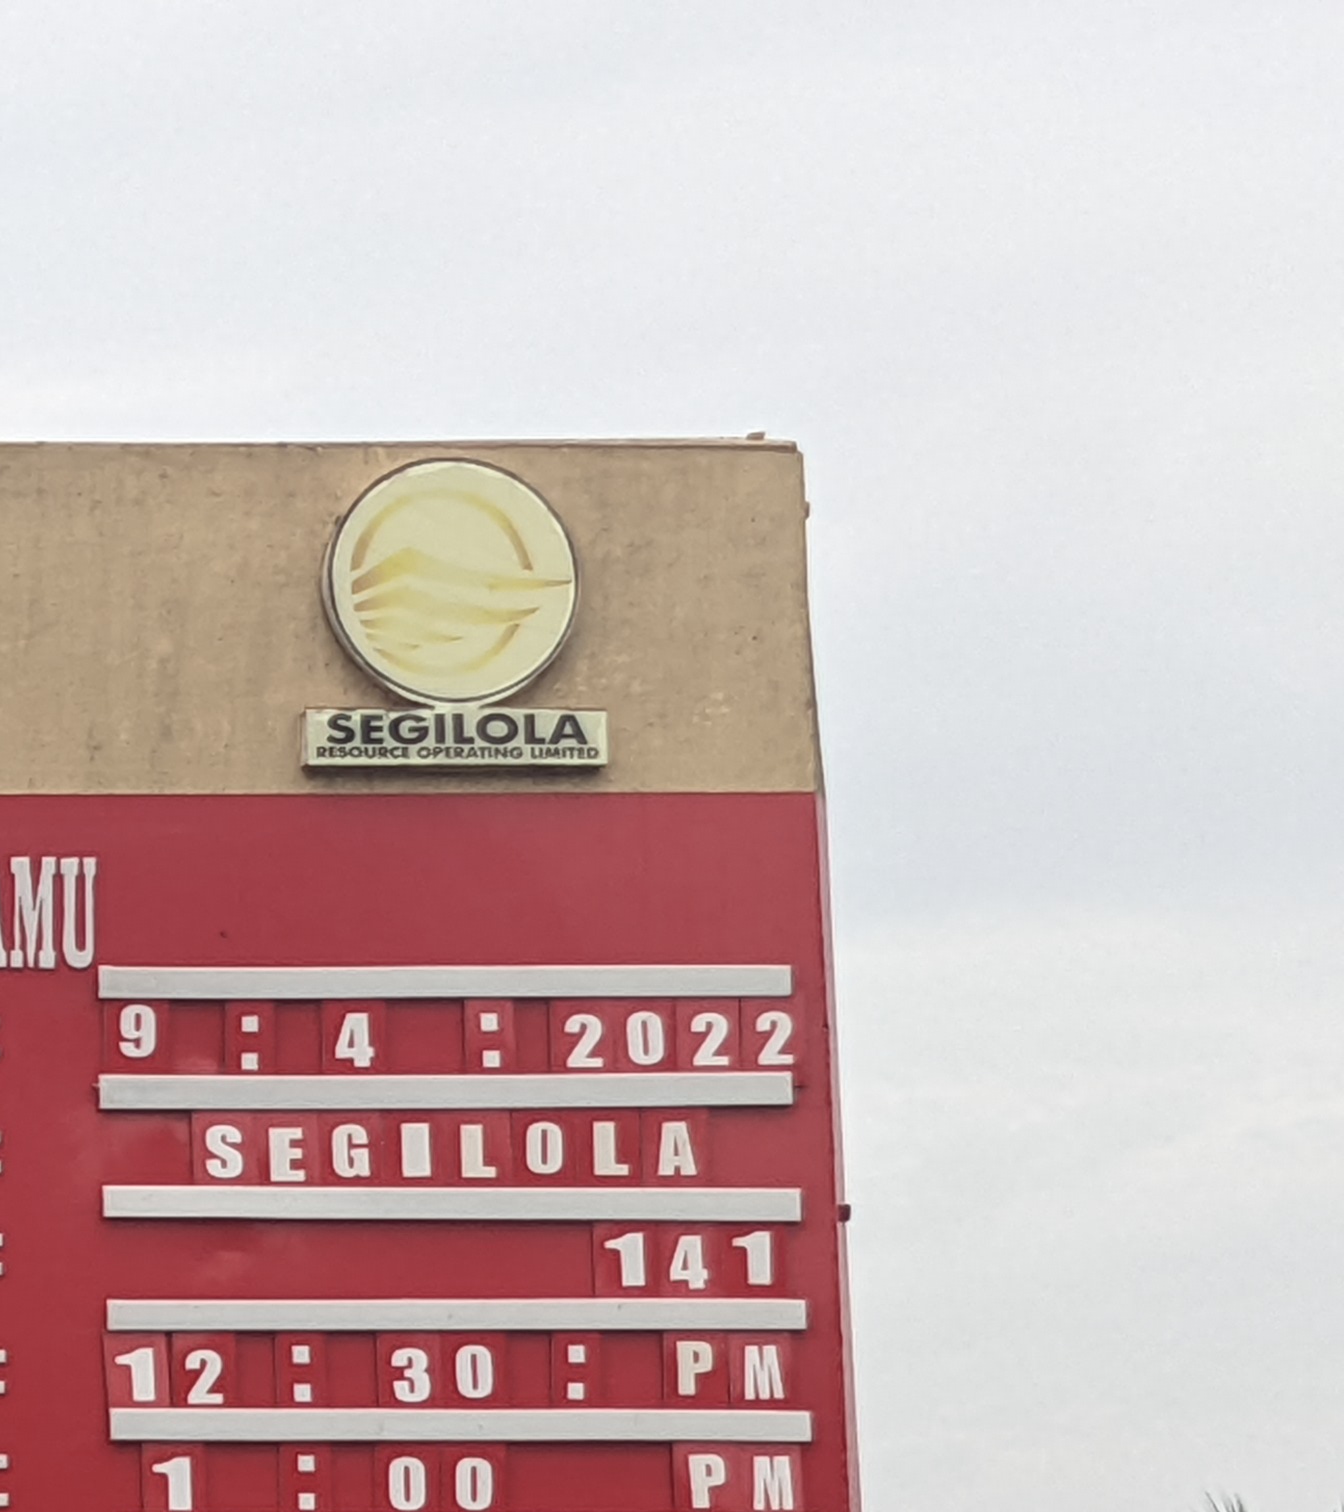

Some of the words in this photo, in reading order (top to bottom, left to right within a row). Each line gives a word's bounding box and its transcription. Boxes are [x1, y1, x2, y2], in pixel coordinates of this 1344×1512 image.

[317, 747, 408, 758] RESOURCE
[418, 747, 522, 759] OPERATING
[531, 748, 598, 759] LIMITED
[327, 714, 588, 744] SEGILOLA
[119, 1003, 158, 1059] 9
[335, 1012, 376, 1068] 4
[564, 1010, 796, 1069] 2022
[205, 1120, 699, 1183] SEGILOLA
[605, 1230, 774, 1291] 141
[115, 1347, 225, 1406] 12
[391, 1344, 495, 1404] 30
[676, 1340, 785, 1401] PM
[152, 1456, 193, 1512] 1
[388, 1456, 494, 1512] 00
[688, 1453, 796, 1512] PM
